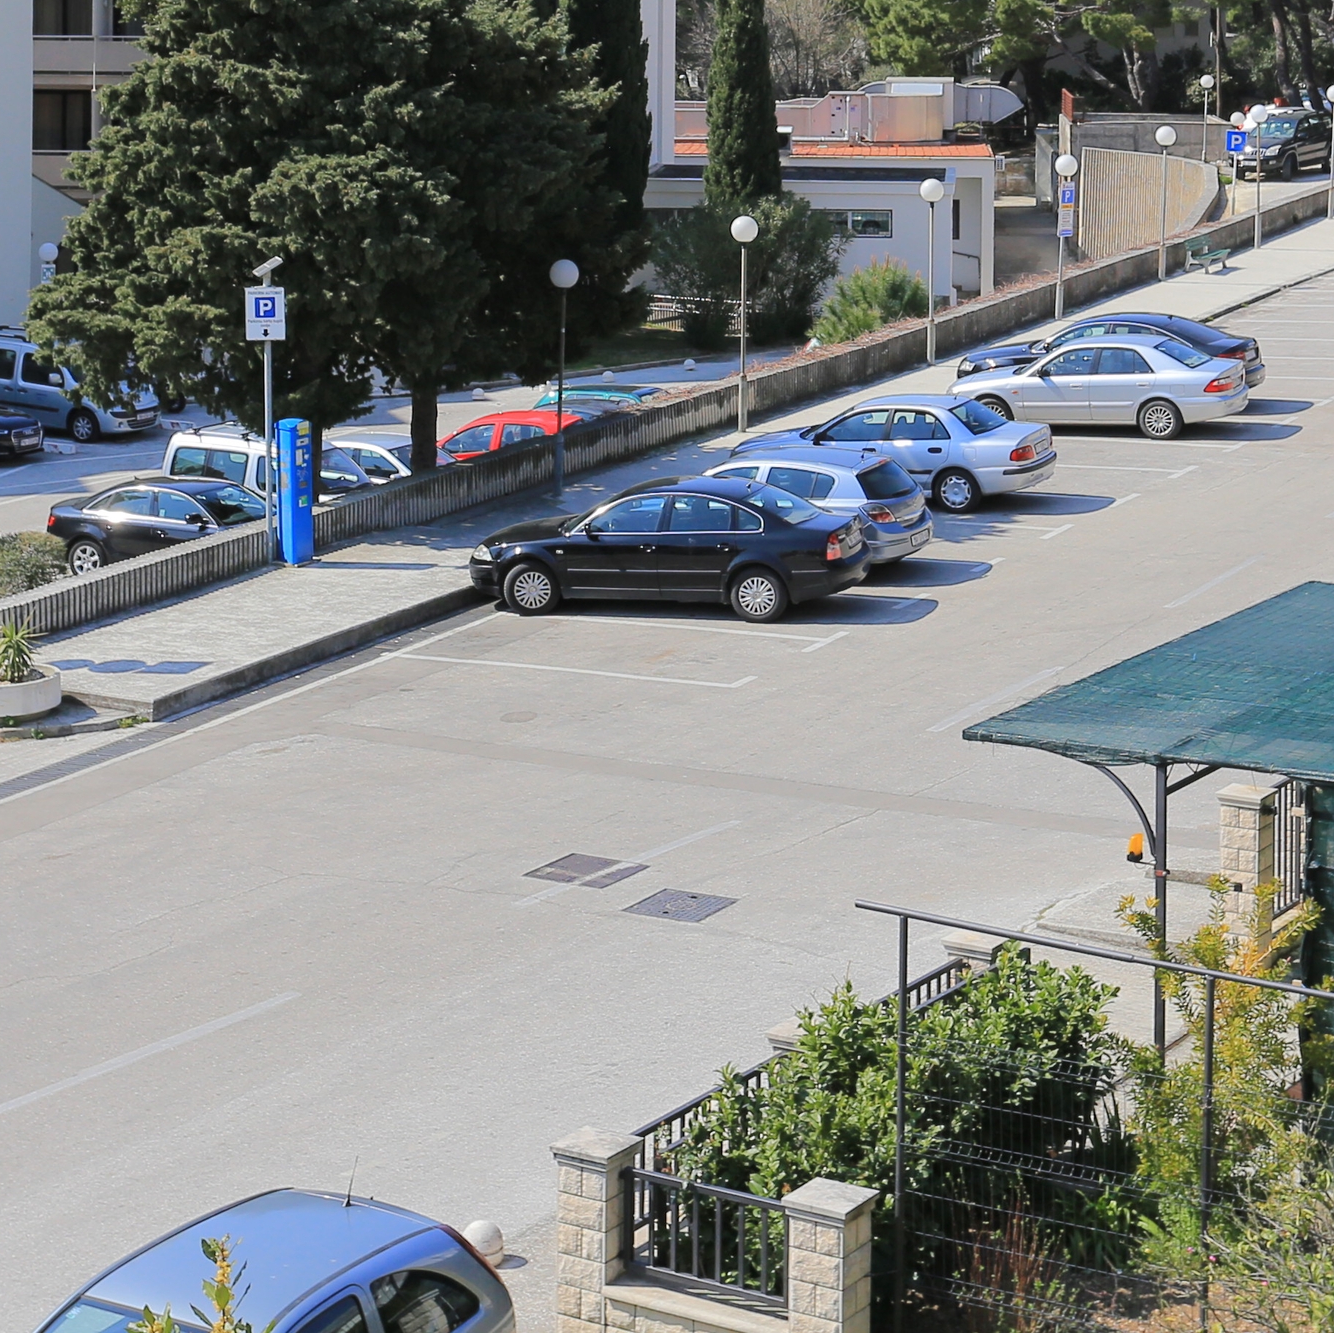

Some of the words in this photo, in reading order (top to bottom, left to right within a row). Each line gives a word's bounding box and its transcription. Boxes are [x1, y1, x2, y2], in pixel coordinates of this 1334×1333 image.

[1231, 134, 1243, 149] P
[1064, 190, 1071, 203] P
[259, 299, 273, 316] P
